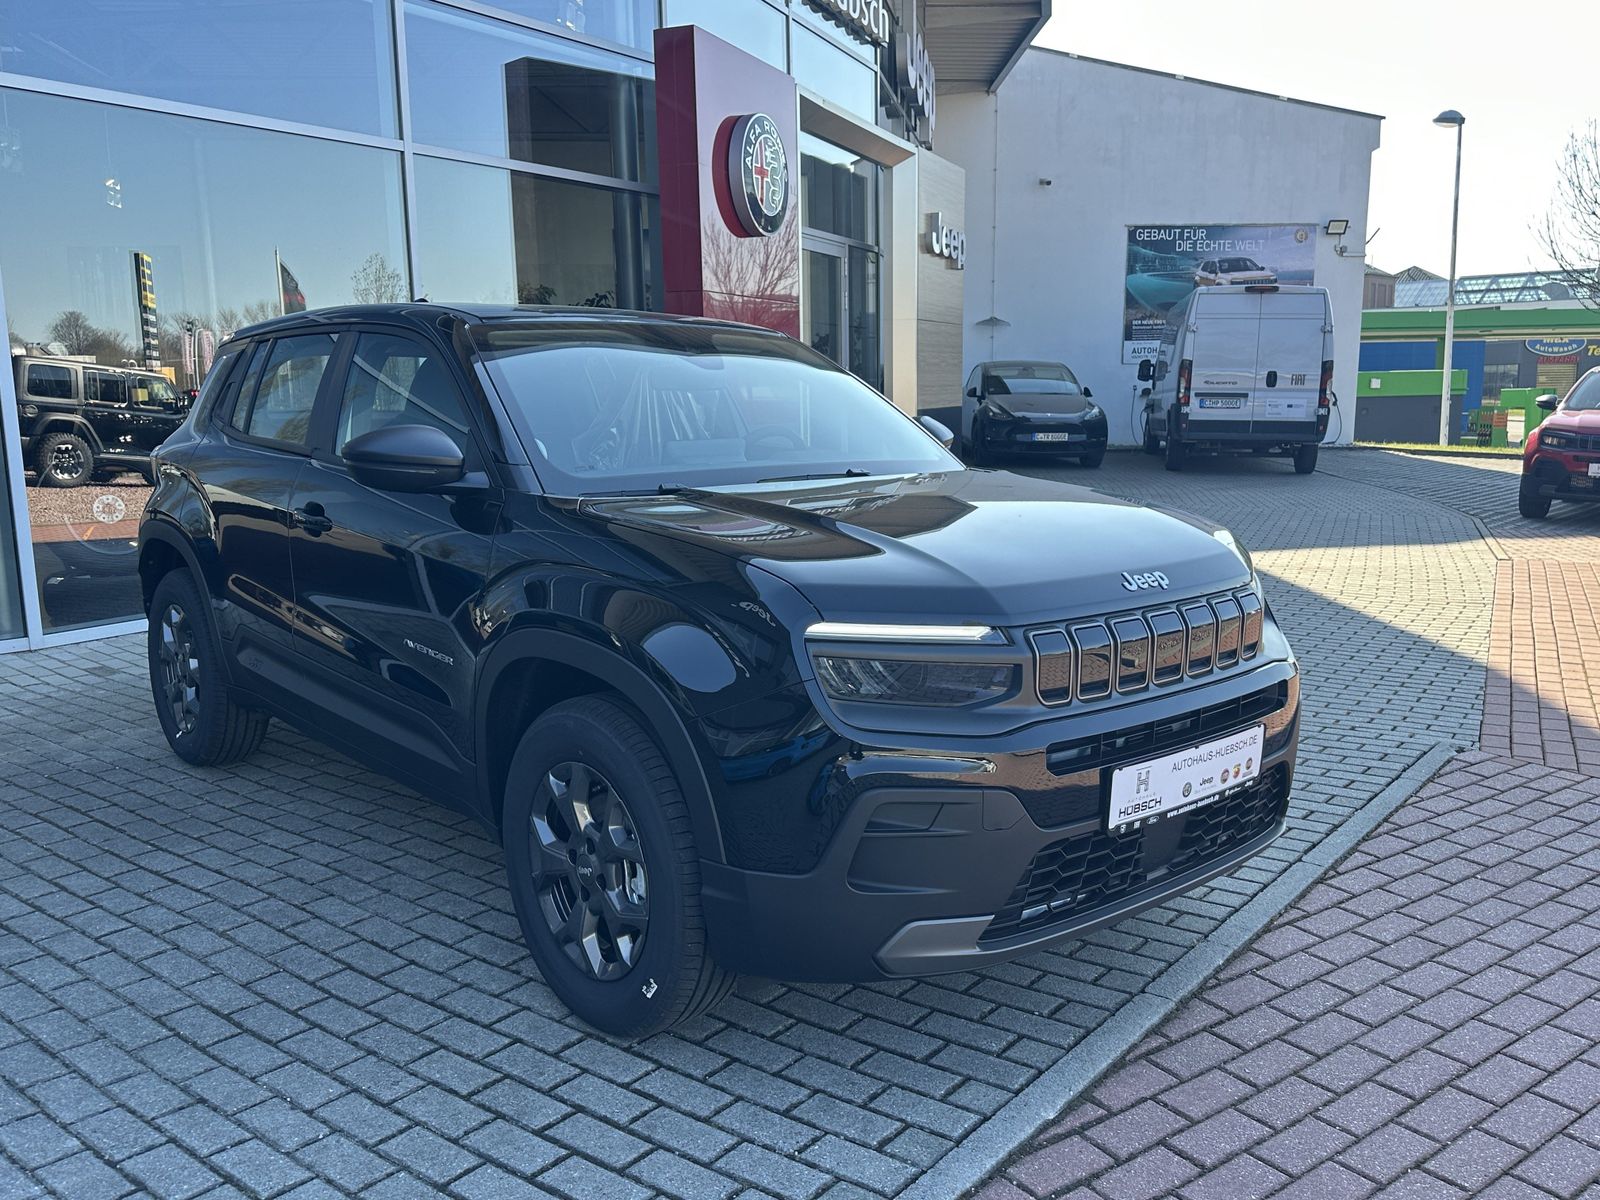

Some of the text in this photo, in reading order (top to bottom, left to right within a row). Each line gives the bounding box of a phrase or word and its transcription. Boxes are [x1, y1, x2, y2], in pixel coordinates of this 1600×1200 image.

[745, 124, 762, 169] ALFA
[1136, 226, 1207, 240] GEBAUT FÜR
[932, 212, 967, 269] Jeep
[1175, 239, 1265, 252] DIE ECHTE WELT
[1131, 347, 1158, 355] AUTOH
[1534, 343, 1578, 353] AutoWasch
[1290, 374, 1307, 386] FIAT
[1121, 571, 1170, 592] Jeep
[1199, 776, 1214, 786] Jeep
